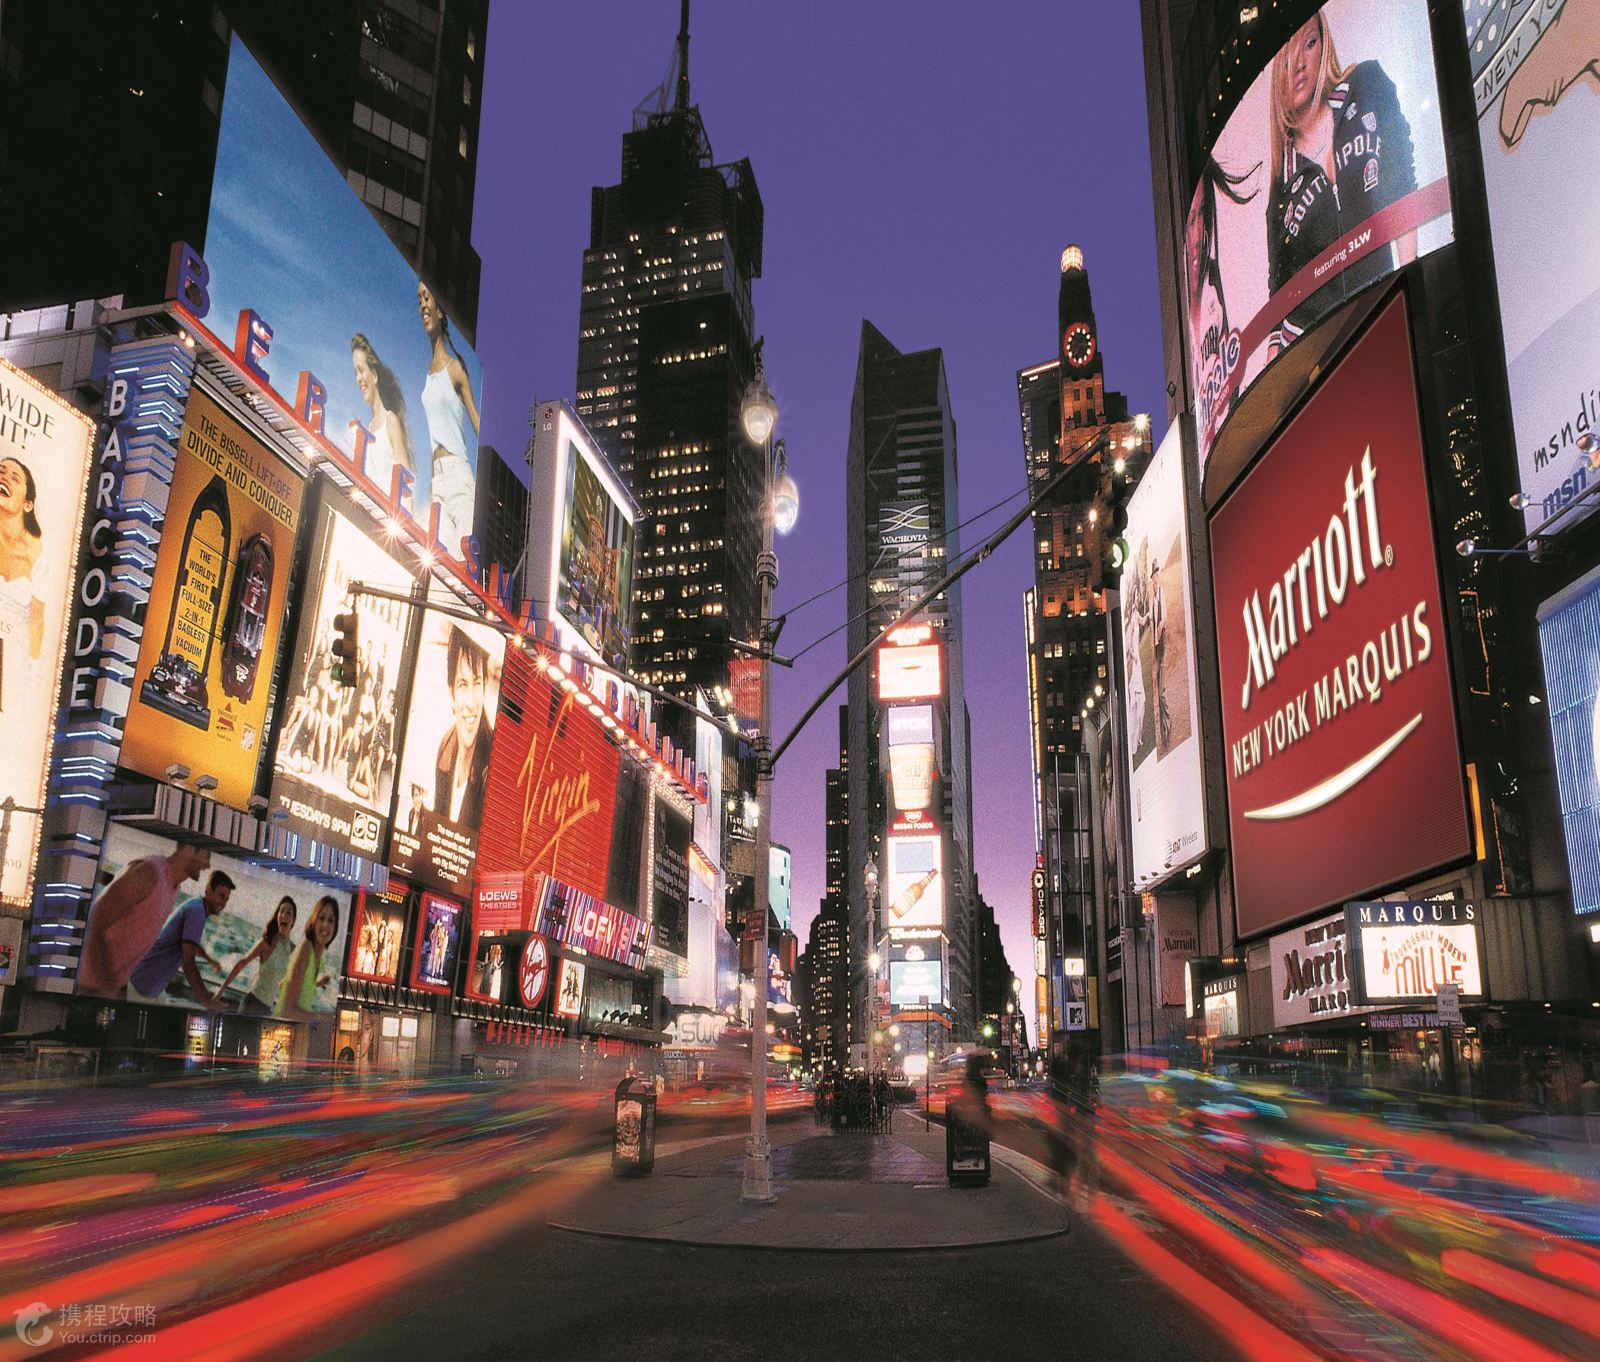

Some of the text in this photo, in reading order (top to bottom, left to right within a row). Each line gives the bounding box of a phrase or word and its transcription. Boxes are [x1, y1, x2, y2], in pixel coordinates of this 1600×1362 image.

[1313, 228, 1372, 279] featuring 3LW
[200, 414, 292, 500] THE BISSELL LIFT-OFF
[187, 430, 294, 528] DIVIDE AND CONQUER.
[1543, 466, 1588, 521] msn
[69, 379, 129, 709] BARCODE
[881, 533, 928, 544] WACHOVIA
[199, 549, 212, 562] THE
[189, 558, 217, 584] WORLD'S
[190, 577, 209, 595] FIRST
[181, 588, 212, 614] FULL-SIZE
[184, 607, 205, 626] 2-IN-1
[177, 620, 206, 643] BAGLESS
[175, 635, 203, 657] VACUUM
[1232, 600, 1433, 779] NEW YORK MARQUIS
[516, 690, 600, 879] Virgin
[279, 795, 351, 837] TUESDAYS 9PM
[479, 890, 519, 902] LOEWS
[479, 901, 518, 910] THEATRES
[1037, 889, 1047, 936] CHASE
[1359, 904, 1475, 924] MARQUIS
[1162, 937, 1197, 953] Marriott
[1436, 933, 1467, 963] MODERN
[1204, 977, 1238, 997] MARQUIS
[1401, 1013, 1425, 1028] BEST
